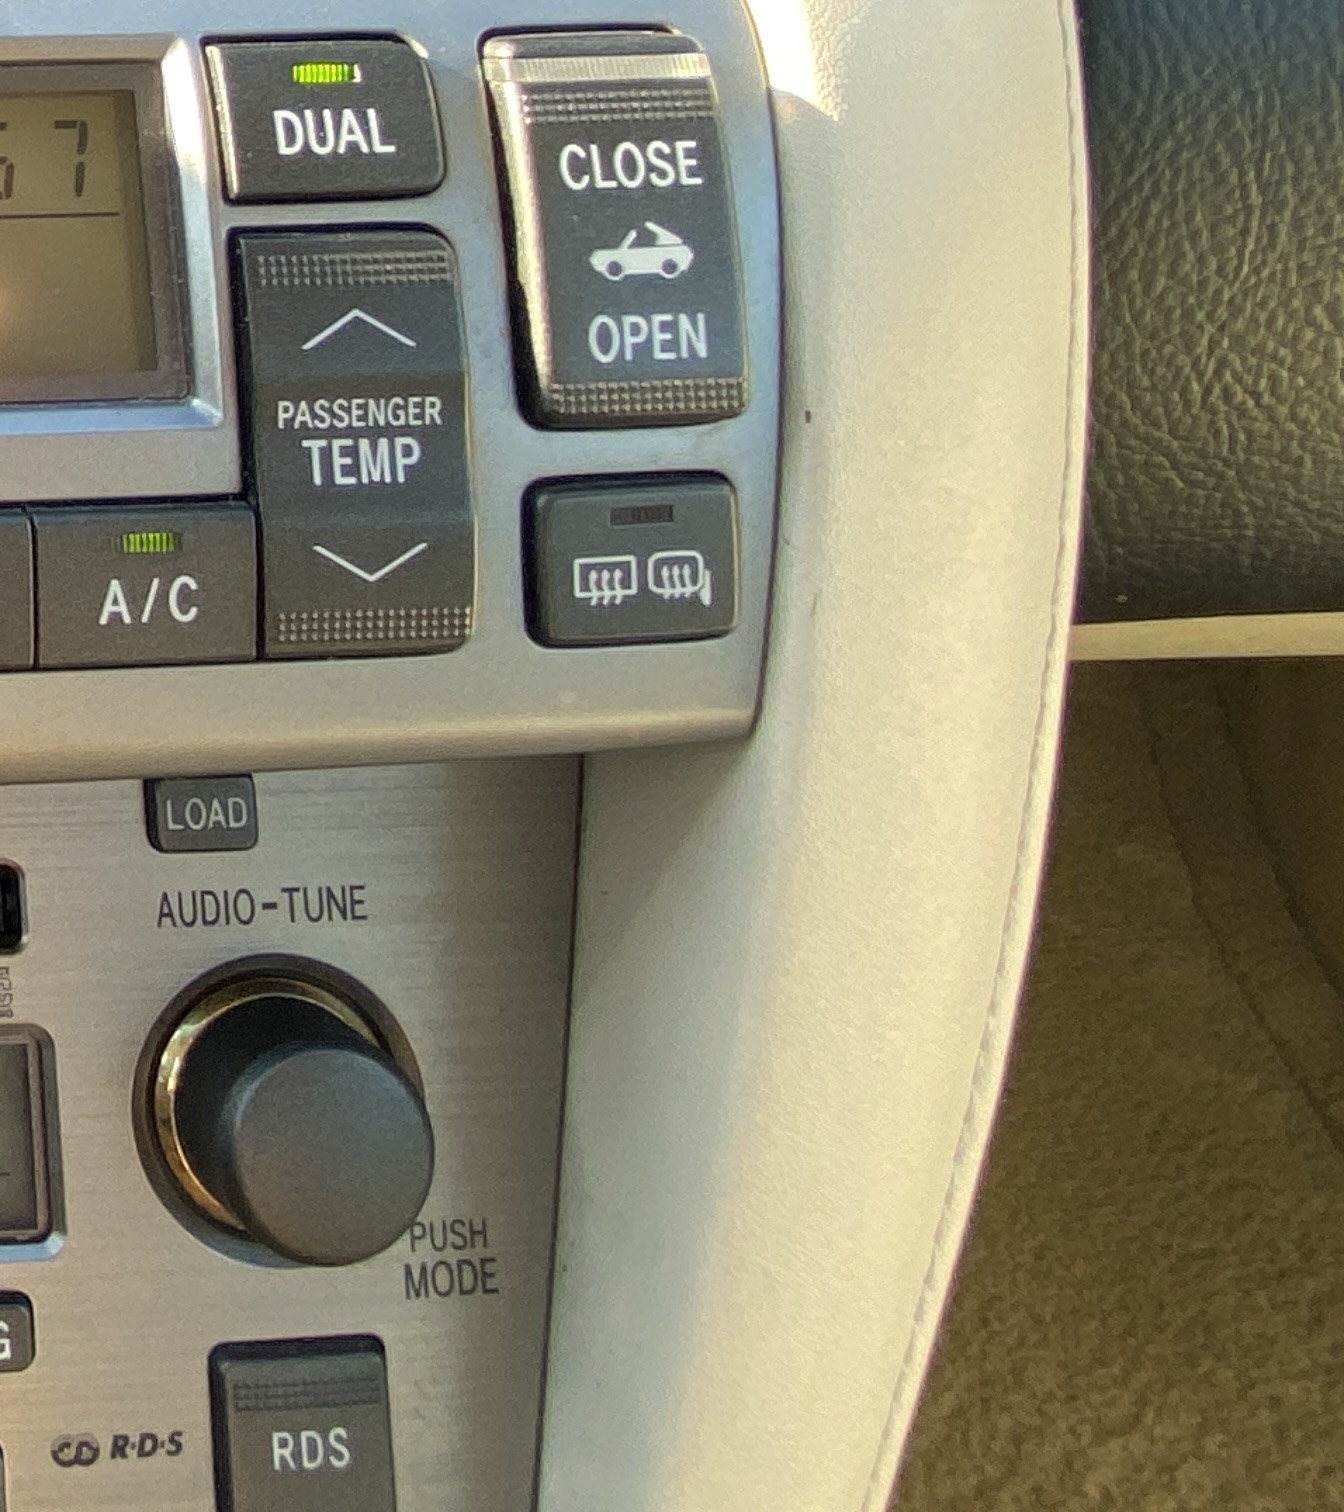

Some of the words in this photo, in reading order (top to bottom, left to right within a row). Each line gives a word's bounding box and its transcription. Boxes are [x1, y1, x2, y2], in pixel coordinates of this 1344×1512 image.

[272, 108, 397, 157] DUAL
[558, 139, 704, 190] CLOSE
[587, 313, 710, 363] OPEN
[276, 396, 443, 429] PASSENGER
[300, 436, 422, 487] TEMP
[98, 575, 199, 626] A/C
[166, 796, 248, 832] LOAD
[409, 1217, 488, 1253] PUSH
[404, 1256, 500, 1300] MODE
[271, 1426, 352, 1472] RDS
